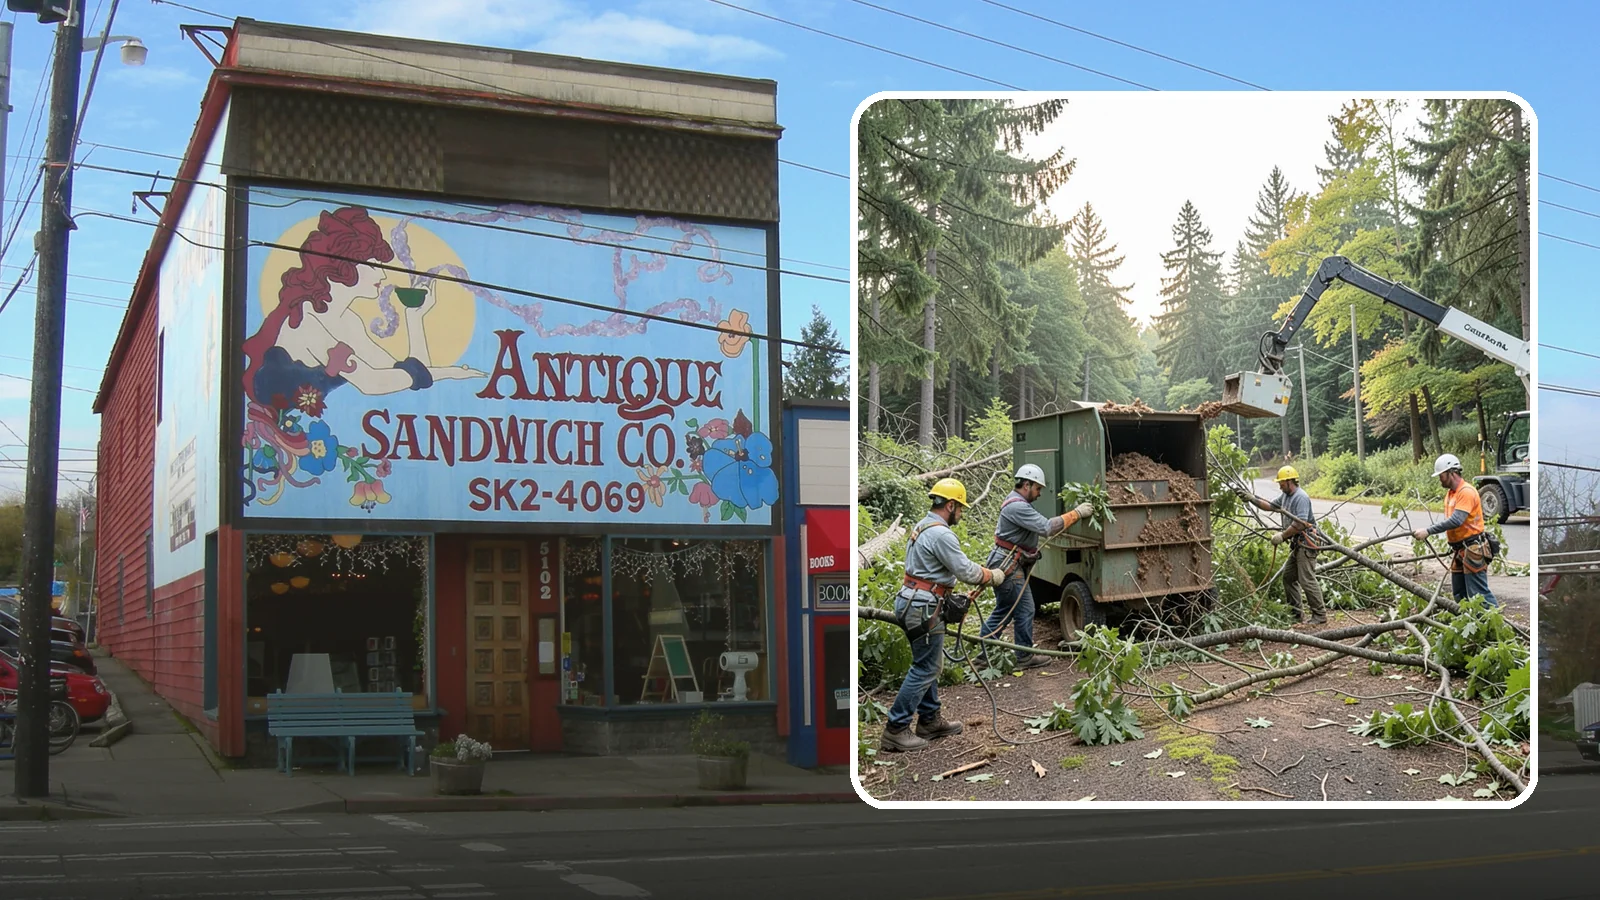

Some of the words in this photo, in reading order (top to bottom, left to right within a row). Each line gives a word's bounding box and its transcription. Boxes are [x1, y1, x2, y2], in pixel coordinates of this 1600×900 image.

[476, 329, 723, 421] ANTIQUE
[361, 408, 604, 467] SANDWICH
[617, 422, 684, 469] CO.
[468, 477, 646, 513] SK2-4069
[540, 541, 551, 600] 5102
[809, 555, 835, 569] BOOKS
